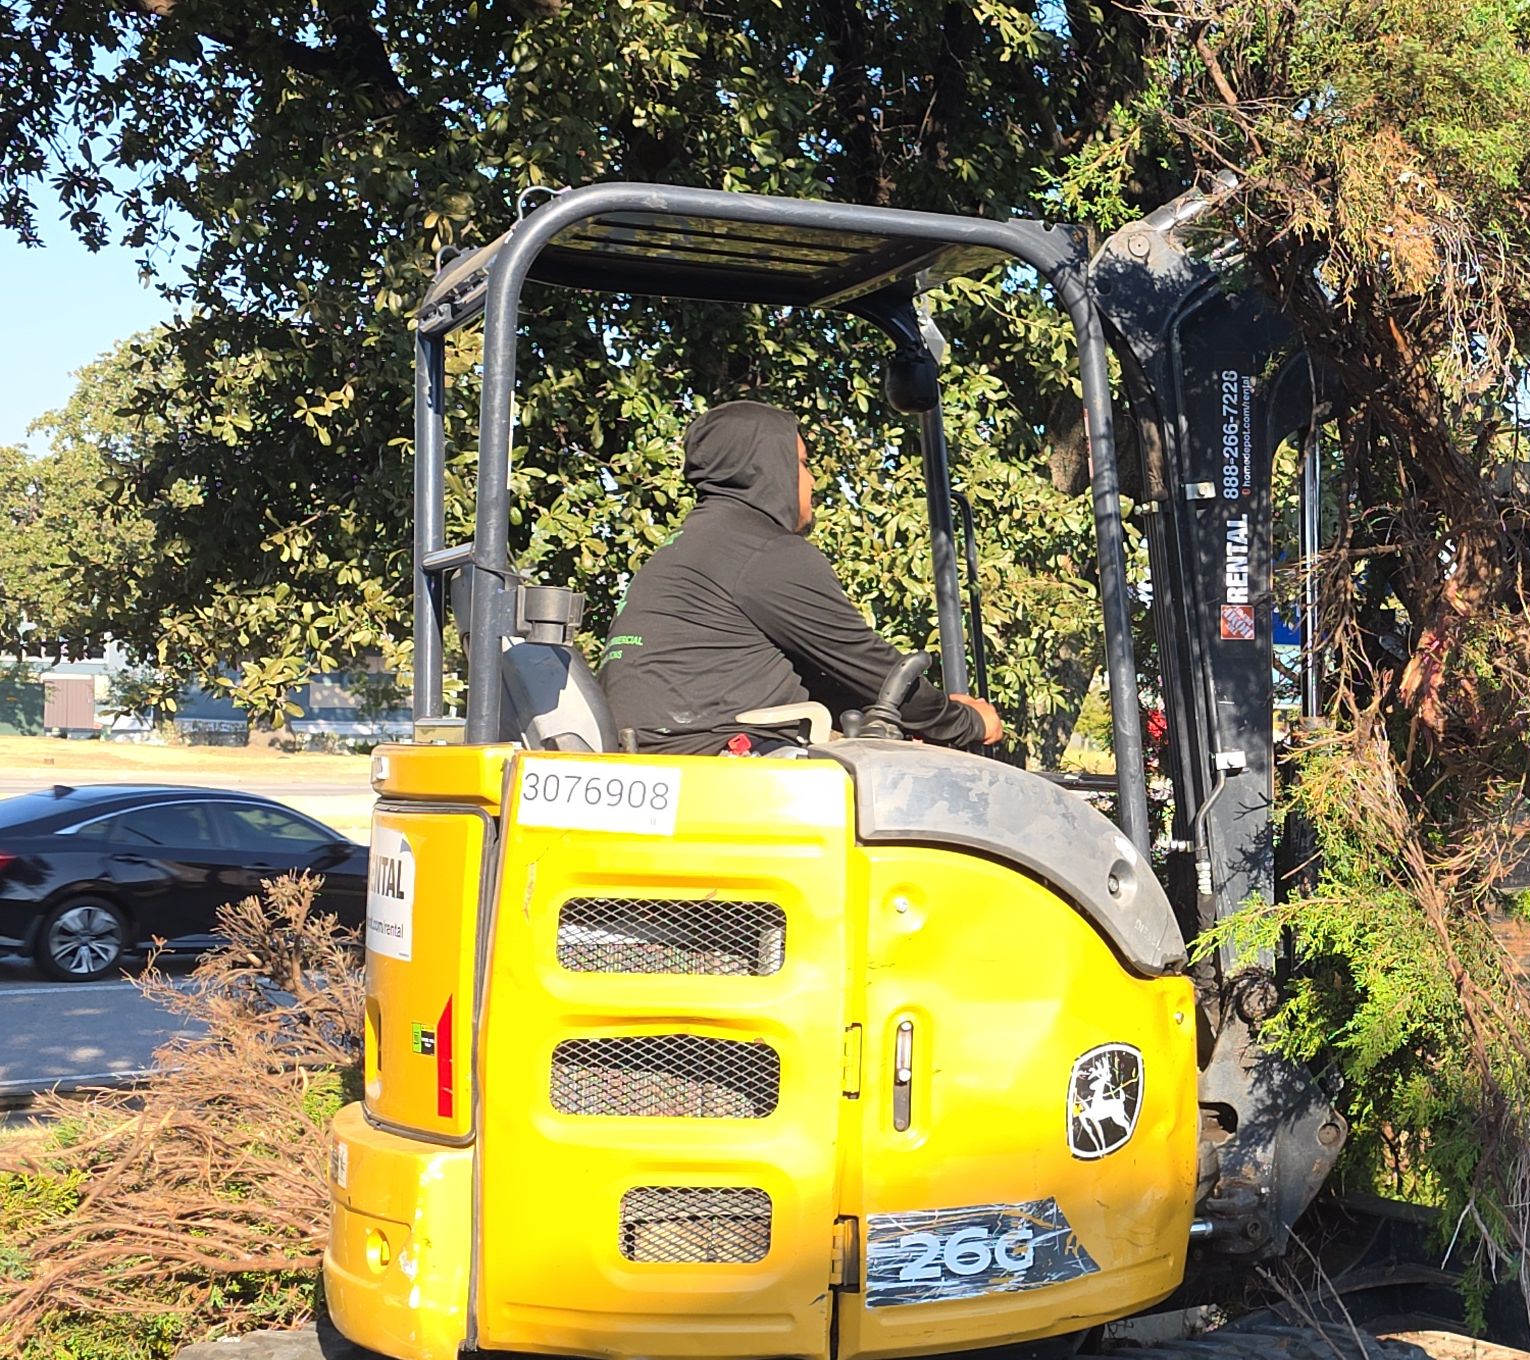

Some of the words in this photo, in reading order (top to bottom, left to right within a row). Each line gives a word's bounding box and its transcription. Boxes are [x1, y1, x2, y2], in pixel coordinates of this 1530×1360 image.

[1222, 371, 1239, 499] 888-266-7228
[1241, 376, 1252, 487] homedepot.com/rental
[1226, 514, 1248, 604] RENTAL
[523, 772, 669, 810] 3076908
[899, 1226, 1035, 1281] 26G
